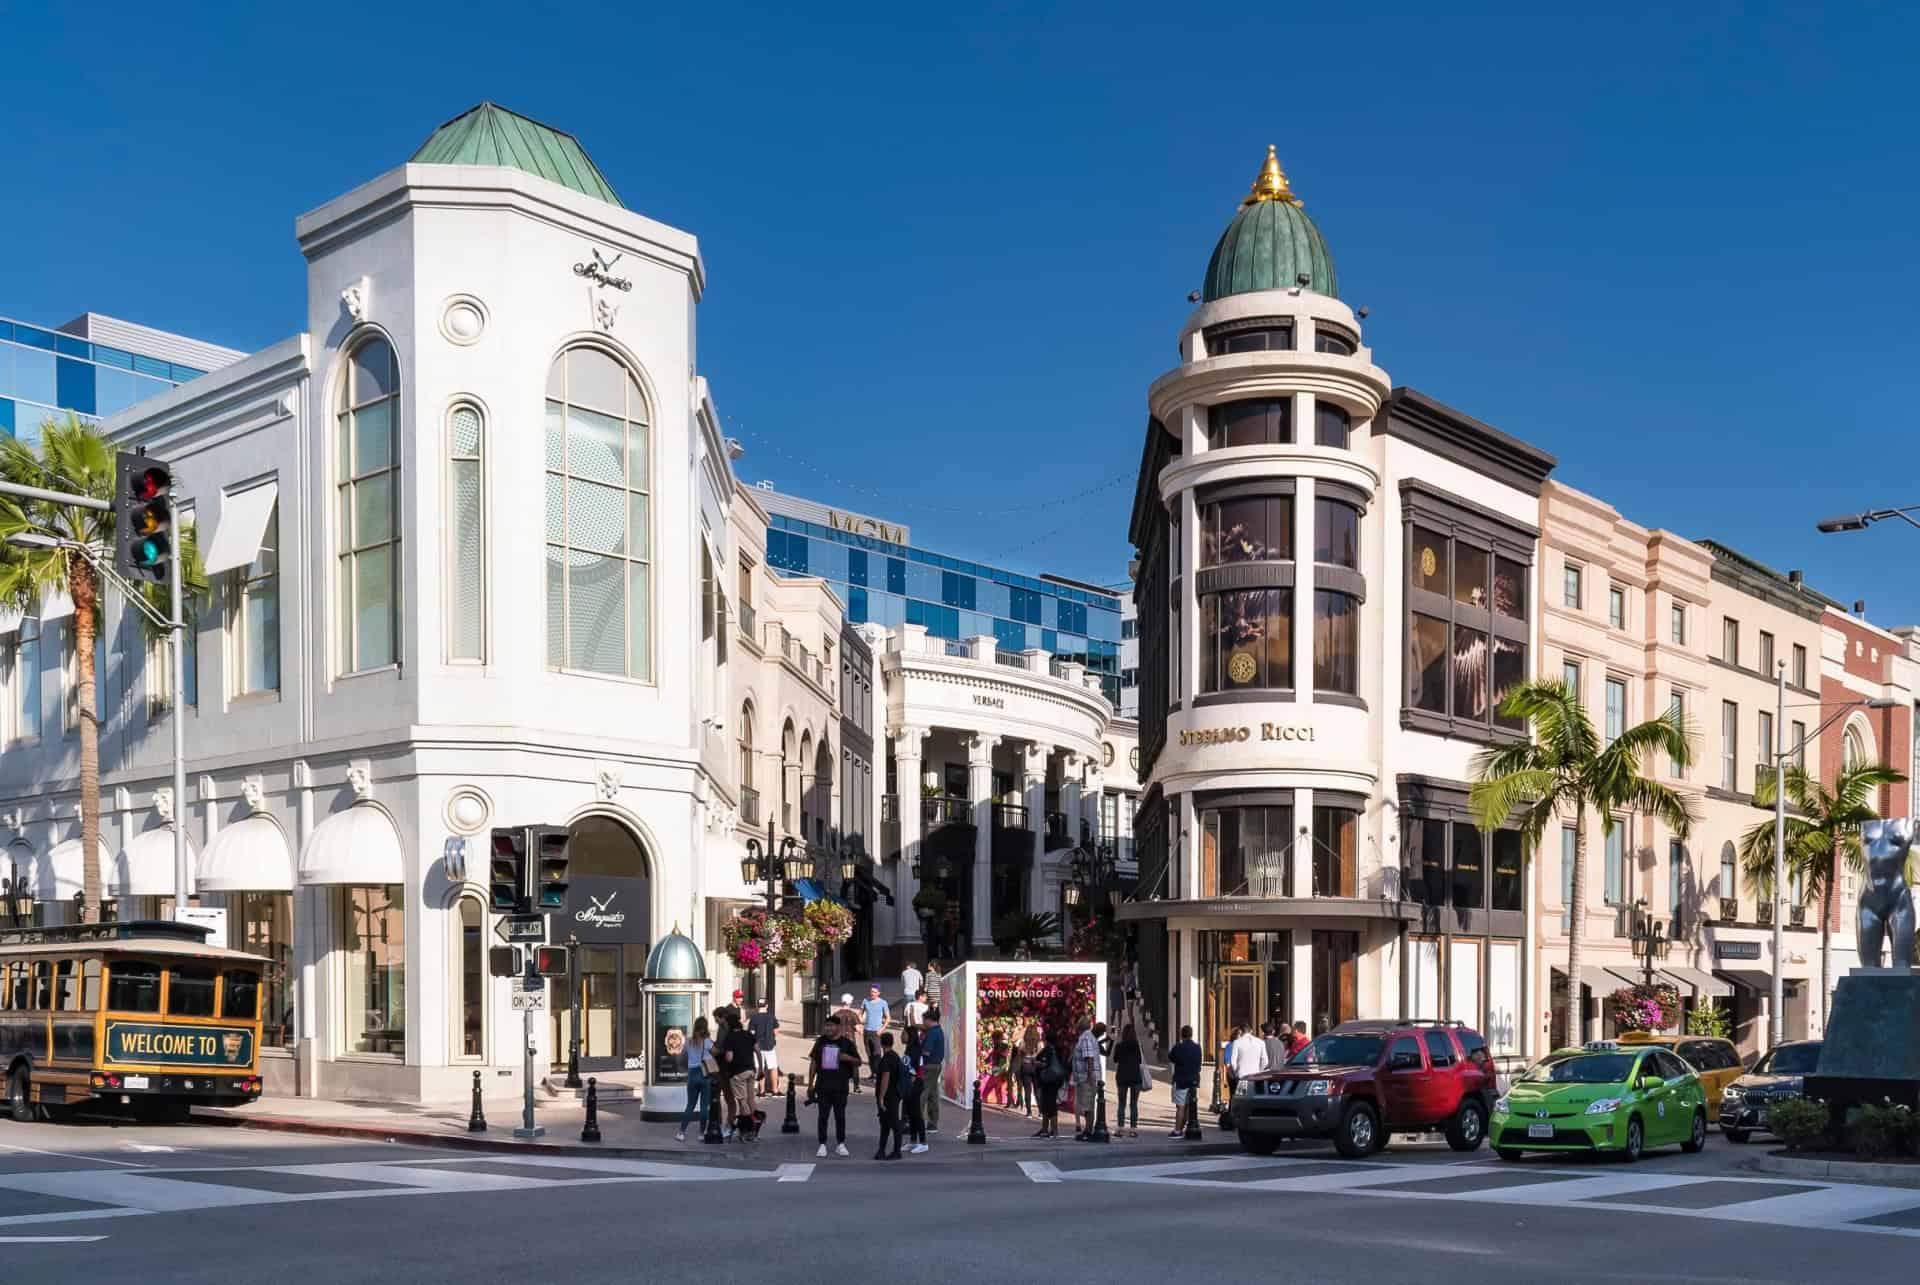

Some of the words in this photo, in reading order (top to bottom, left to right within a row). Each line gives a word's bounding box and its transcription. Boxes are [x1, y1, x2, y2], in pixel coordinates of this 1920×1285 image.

[829, 509, 907, 545] MGM
[120, 1033, 195, 1055] WELCOME
[199, 1036, 217, 1056] TO
